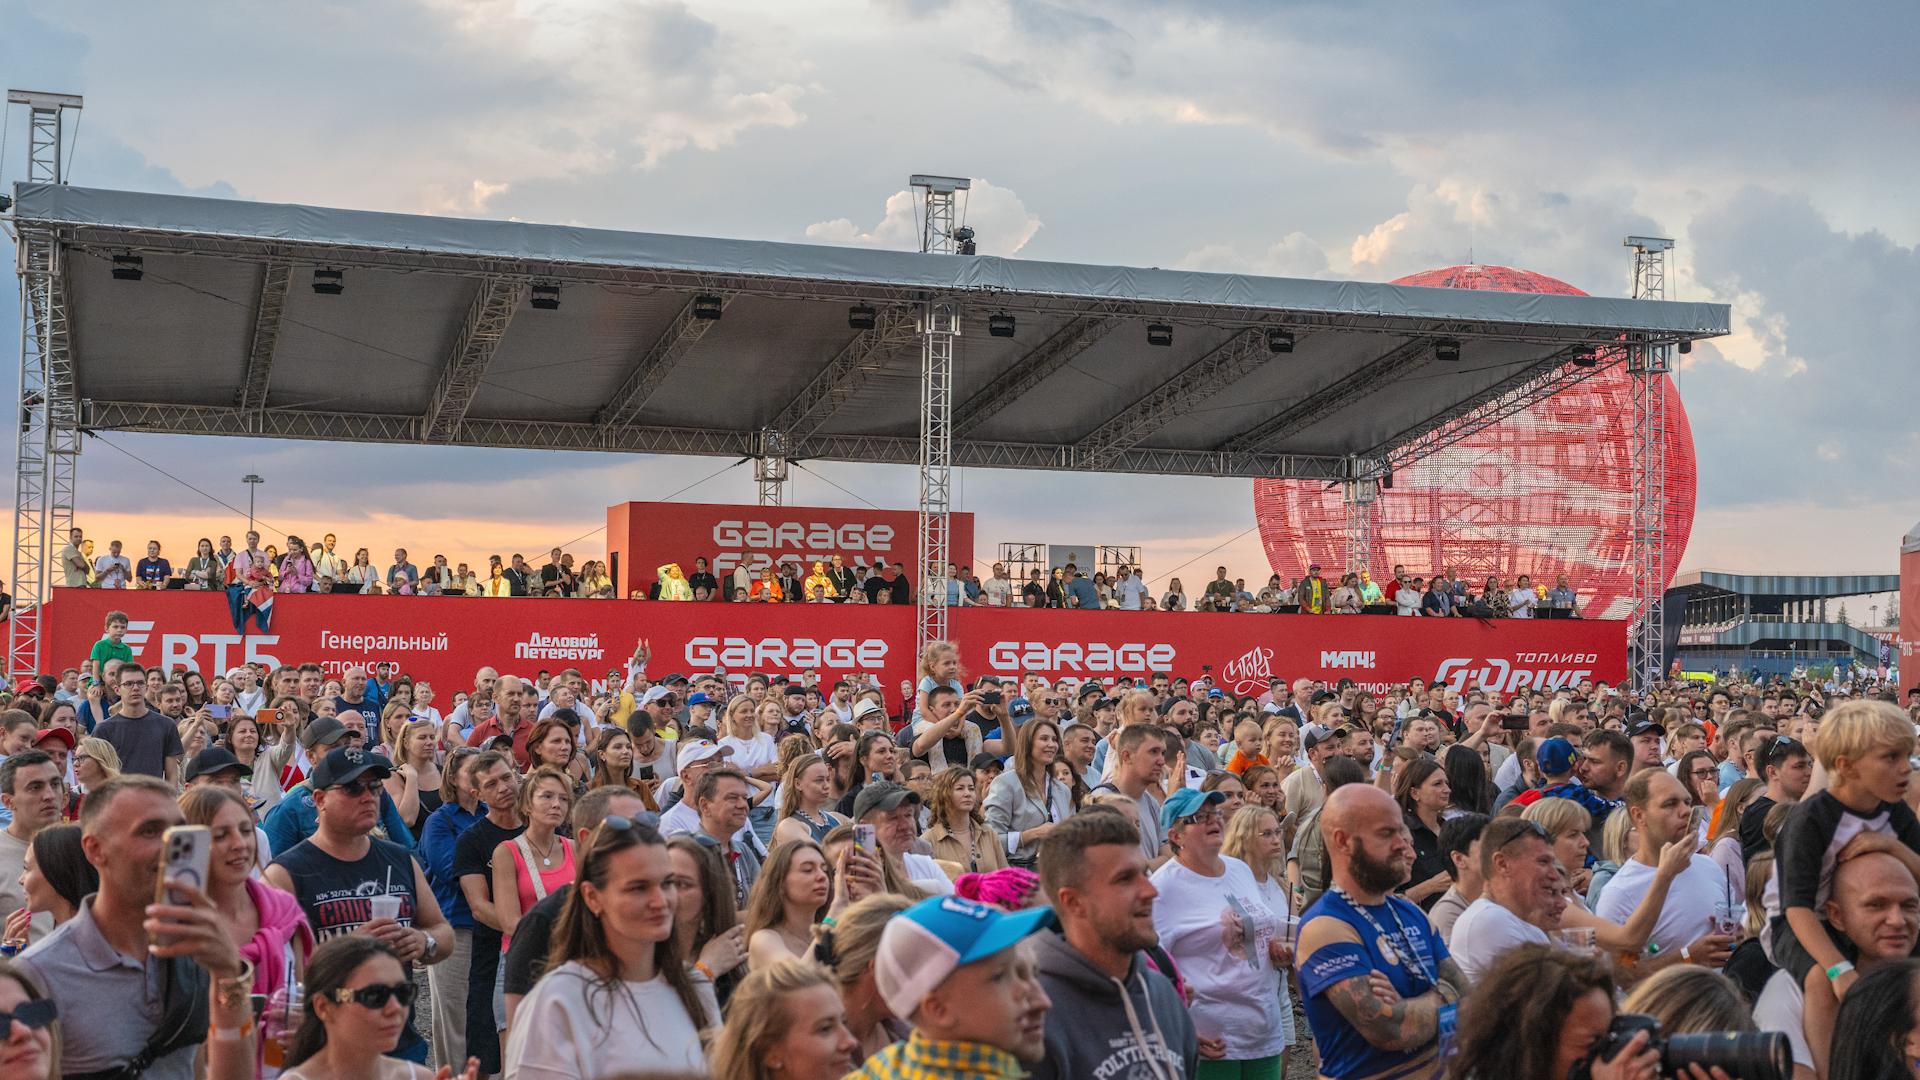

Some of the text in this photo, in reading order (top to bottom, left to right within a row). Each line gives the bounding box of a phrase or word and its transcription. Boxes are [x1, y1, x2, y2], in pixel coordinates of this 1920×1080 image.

[321, 630, 448, 654] Генеральный
[529, 632, 599, 648] Деловой
[162, 633, 282, 681] ВТБ
[515, 642, 605, 660] Петербург
[1320, 650, 1376, 669] МАТЧ!
[1516, 652, 1598, 664] ТОПЛИВО
